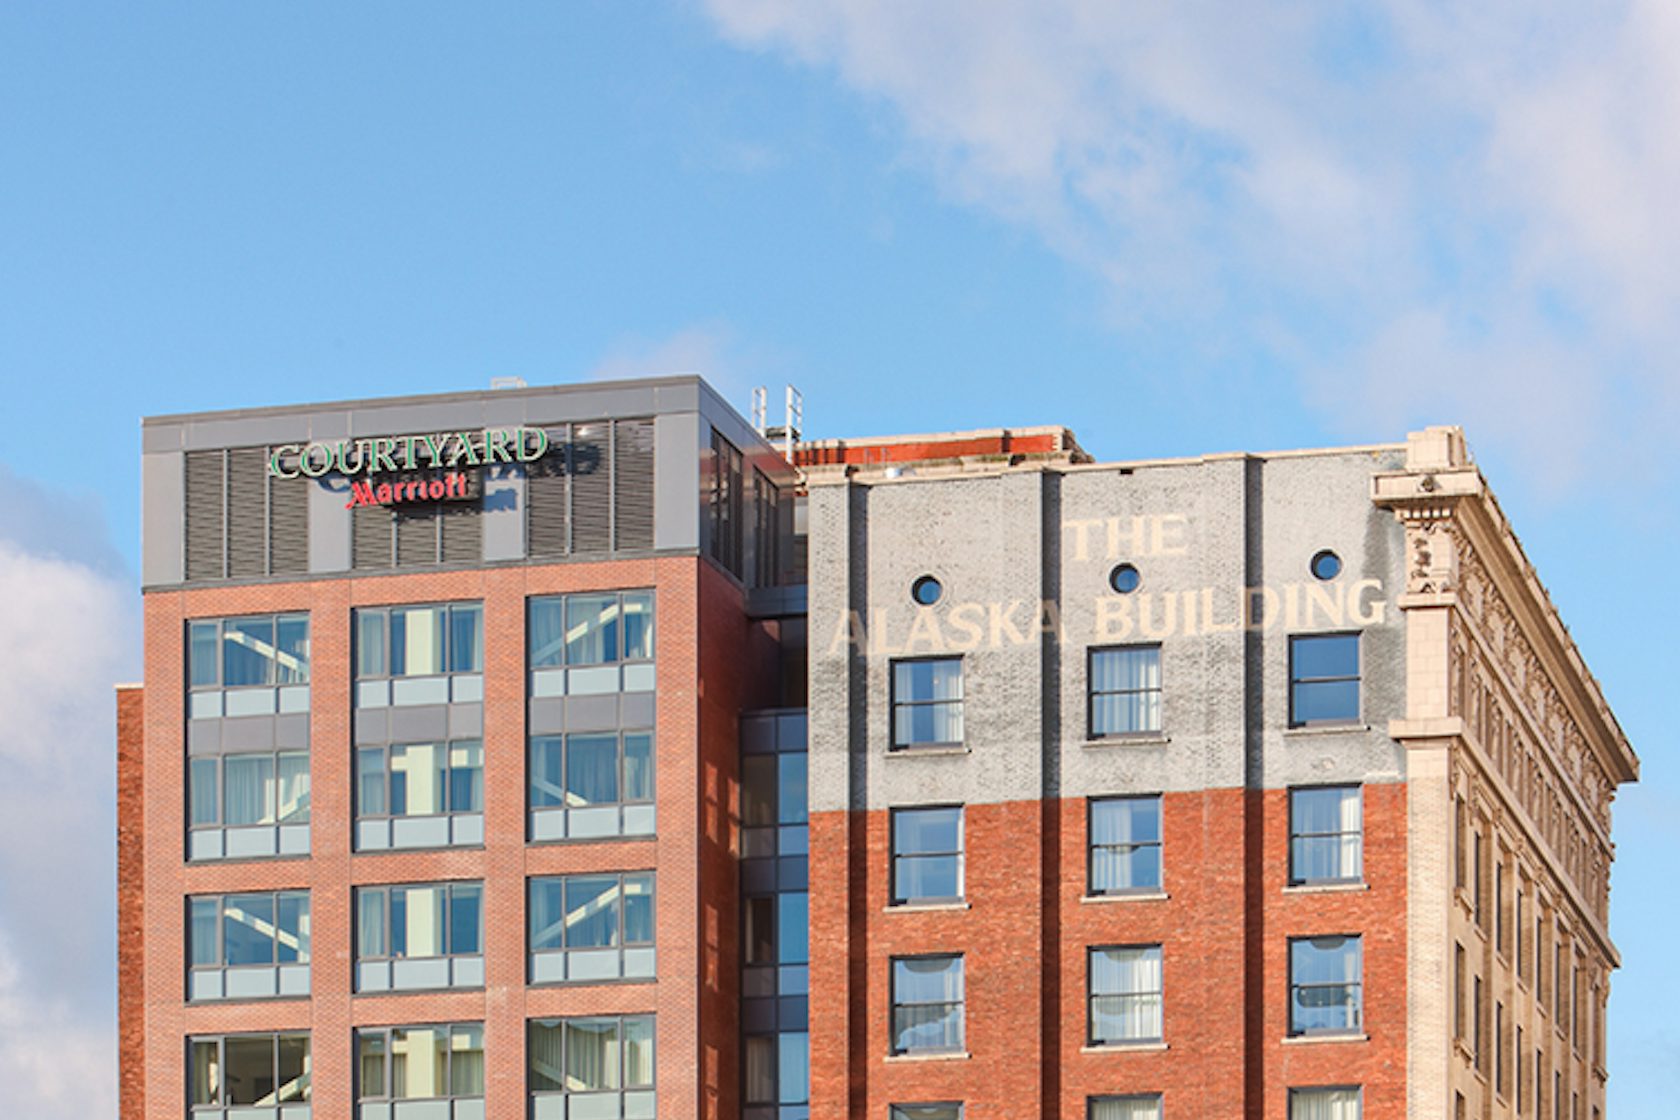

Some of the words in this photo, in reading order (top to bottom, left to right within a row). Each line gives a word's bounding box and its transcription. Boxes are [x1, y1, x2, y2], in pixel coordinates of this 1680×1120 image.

[269, 427, 549, 479] COURTYARD
[345, 472, 466, 509] Marriott
[1062, 513, 1187, 561] THE
[828, 599, 1068, 656] ALASKA
[1095, 578, 1387, 640] BUILDING
